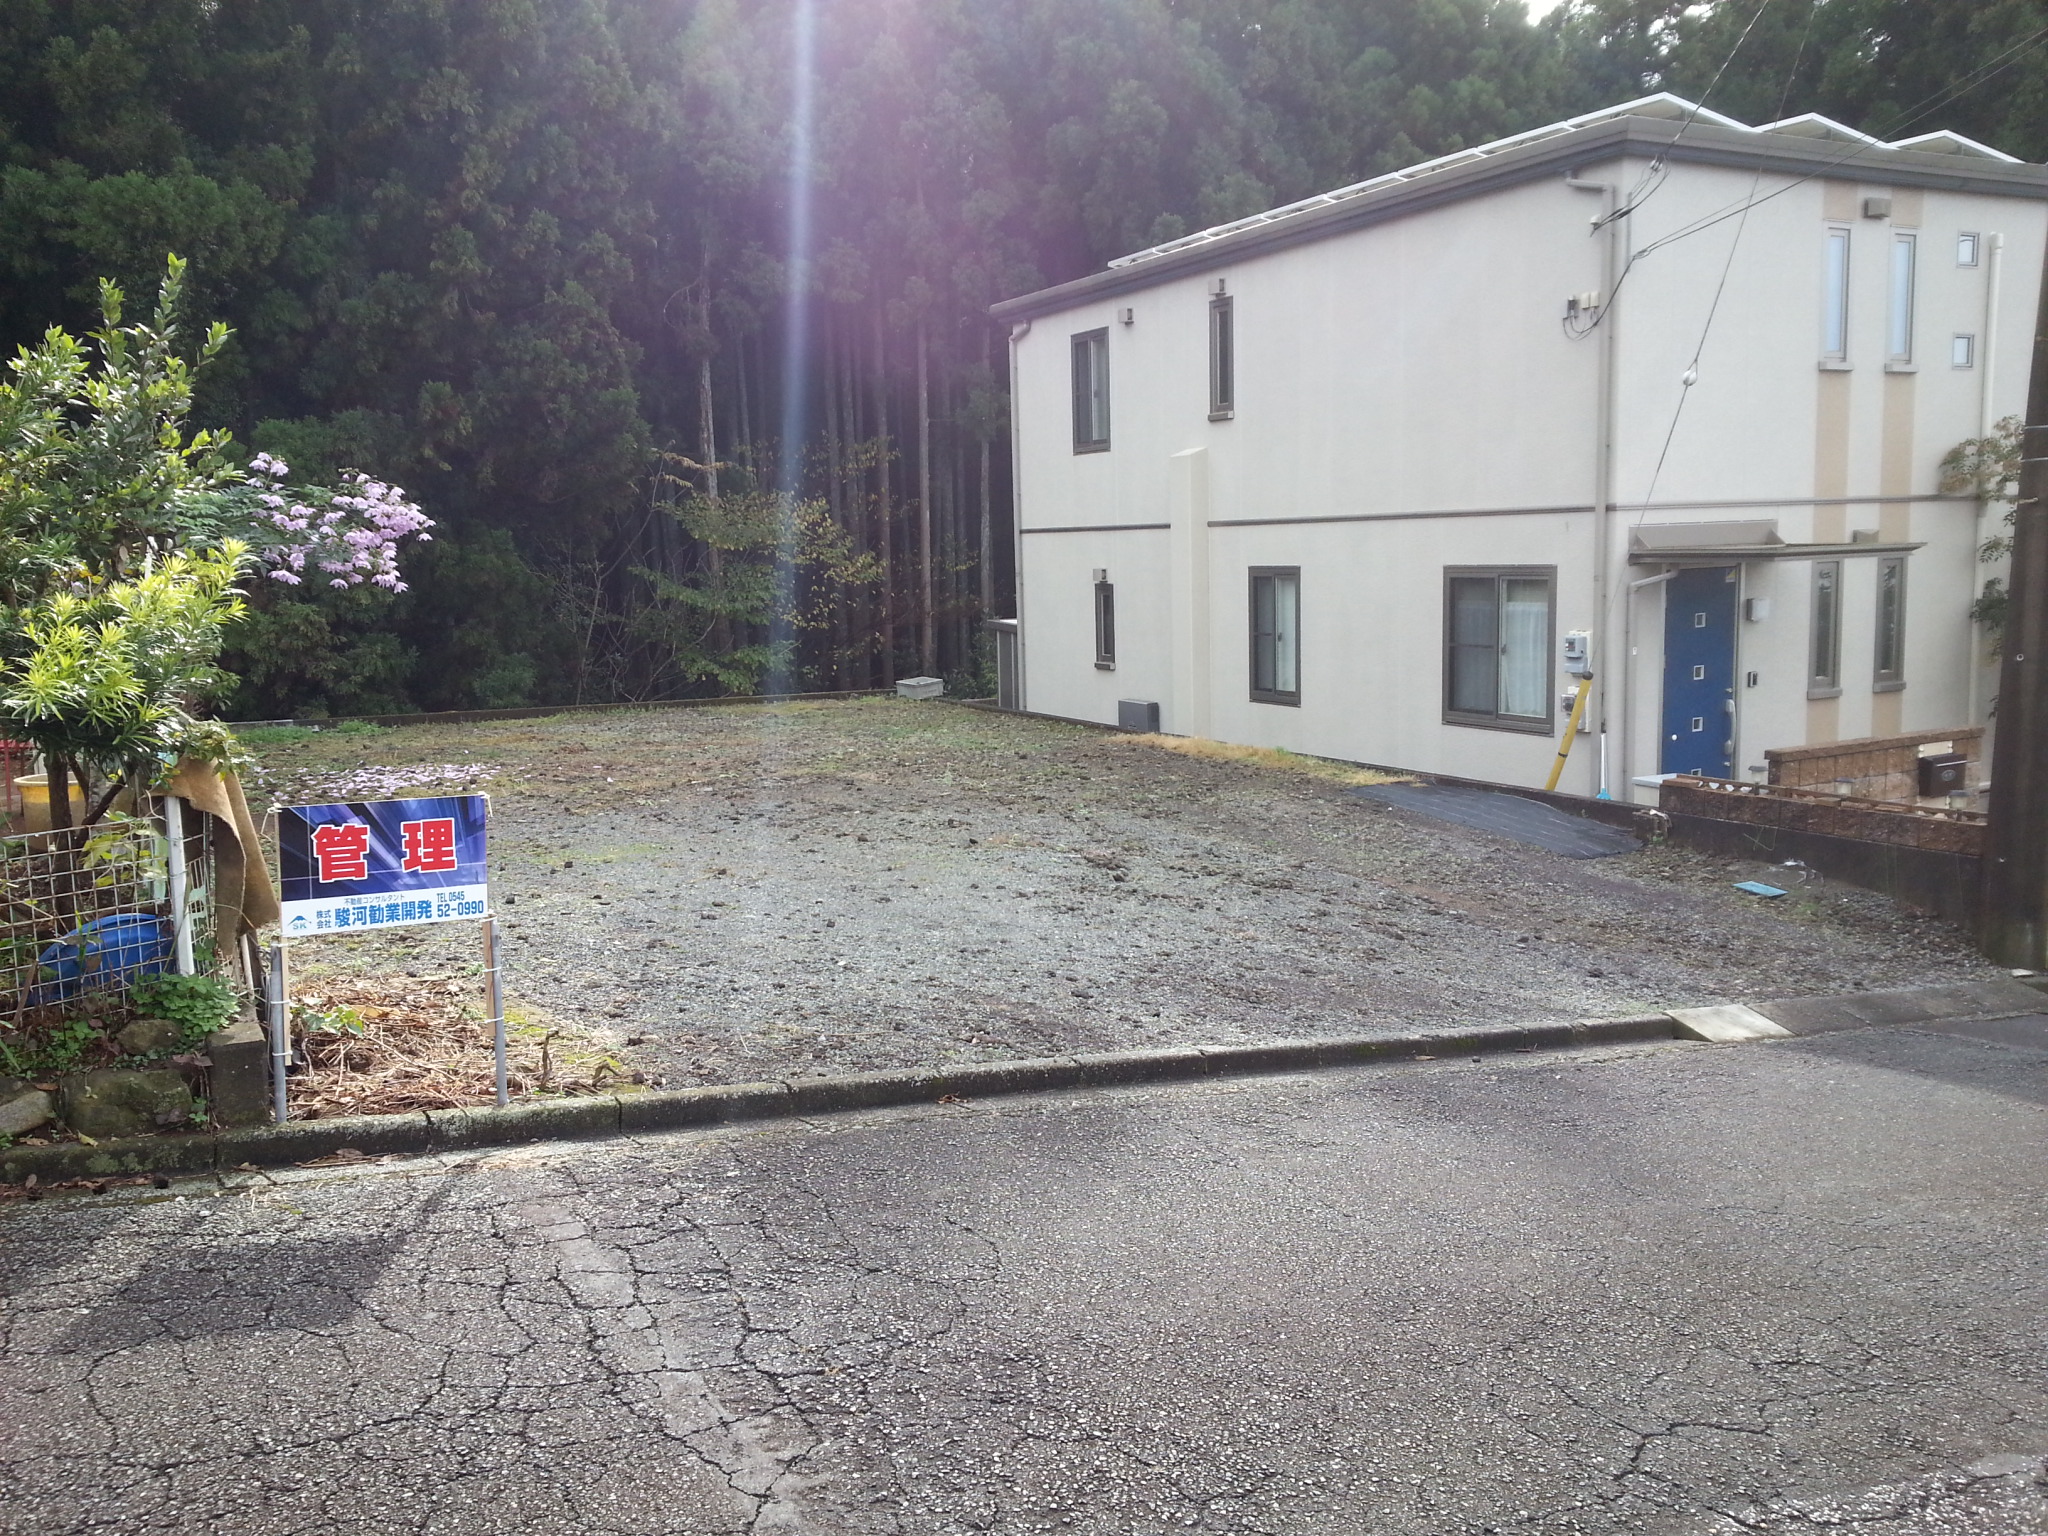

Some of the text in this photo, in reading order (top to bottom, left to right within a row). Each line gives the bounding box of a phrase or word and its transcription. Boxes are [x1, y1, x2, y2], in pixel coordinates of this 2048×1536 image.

[311, 817, 457, 883] 管理
[343, 894, 405, 905] 不動産コンサルタント
[437, 891, 465, 902] TEL 0545
[334, 900, 432, 928] 駿河勧業開発
[437, 900, 484, 918] 52-0990
